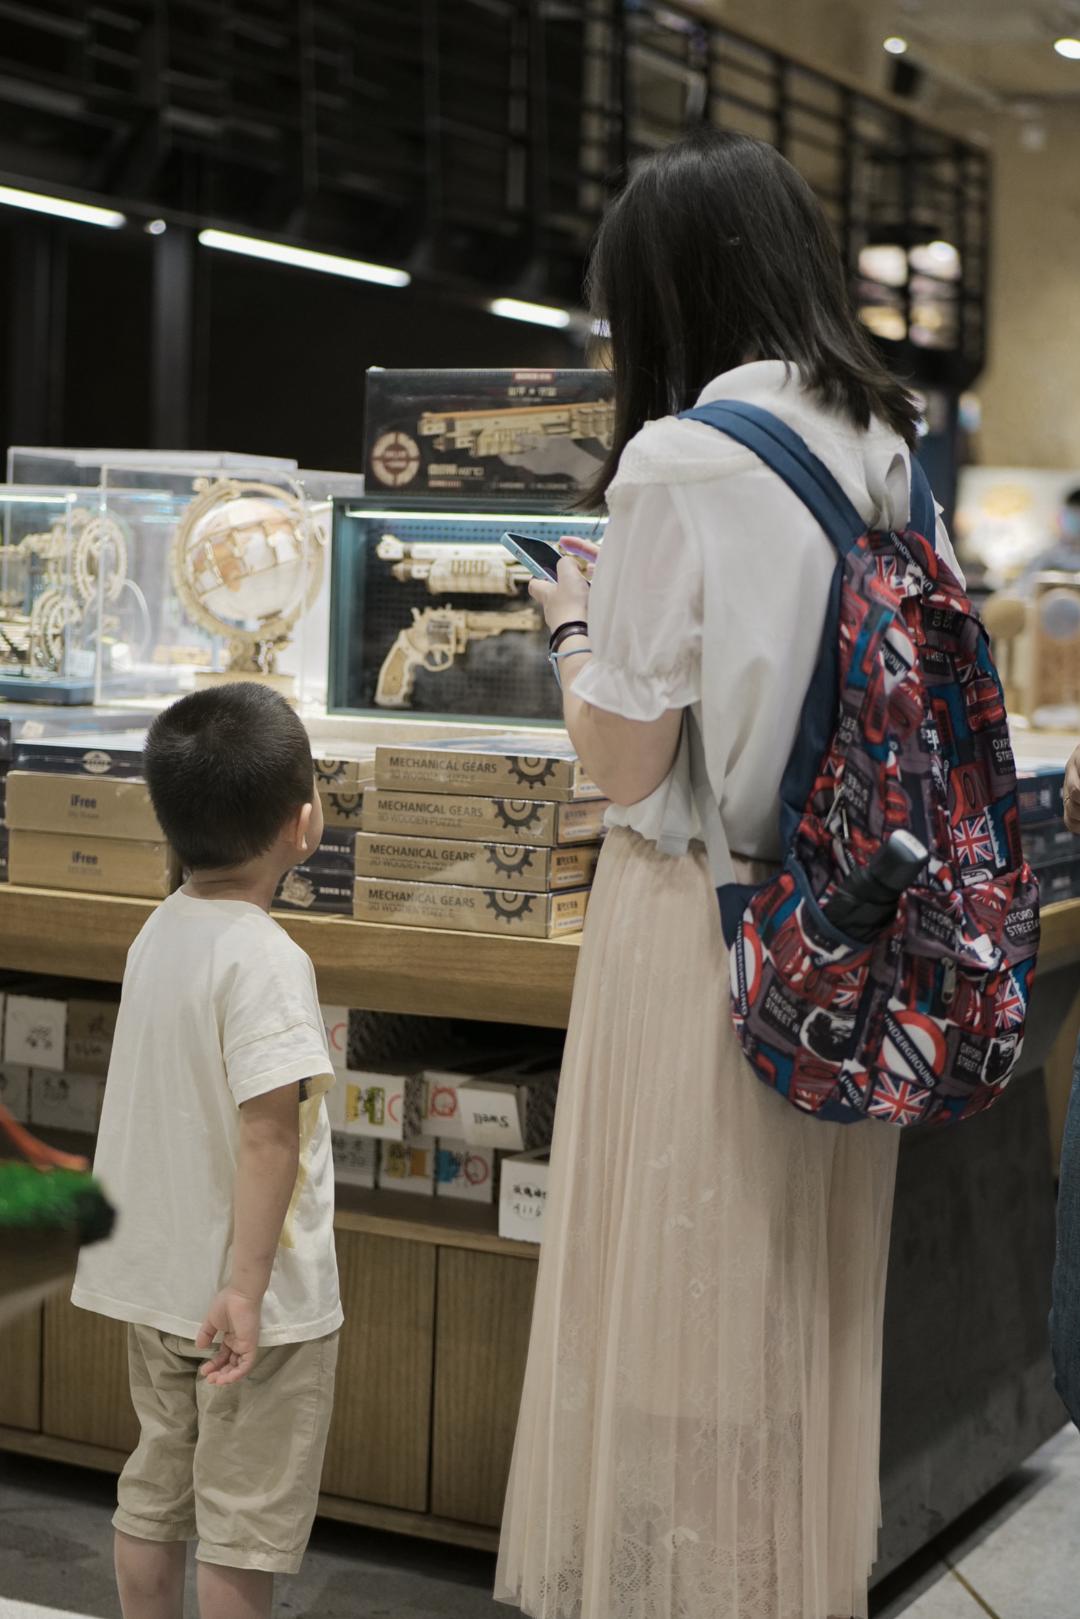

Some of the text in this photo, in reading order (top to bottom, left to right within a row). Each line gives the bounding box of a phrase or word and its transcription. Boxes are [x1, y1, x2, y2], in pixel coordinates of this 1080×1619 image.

[389, 756, 497, 773] MECHANICAL GEARS
[70, 794, 97, 808] iFree
[378, 800, 483, 818] MECHANICAL GEARS
[72, 851, 98, 865] iFree
[369, 844, 476, 861] MECHANICAL GEARS
[440, 895, 476, 908] GEARS
[768, 985, 798, 1019] OXFORD
[765, 997, 792, 1028] STREET
